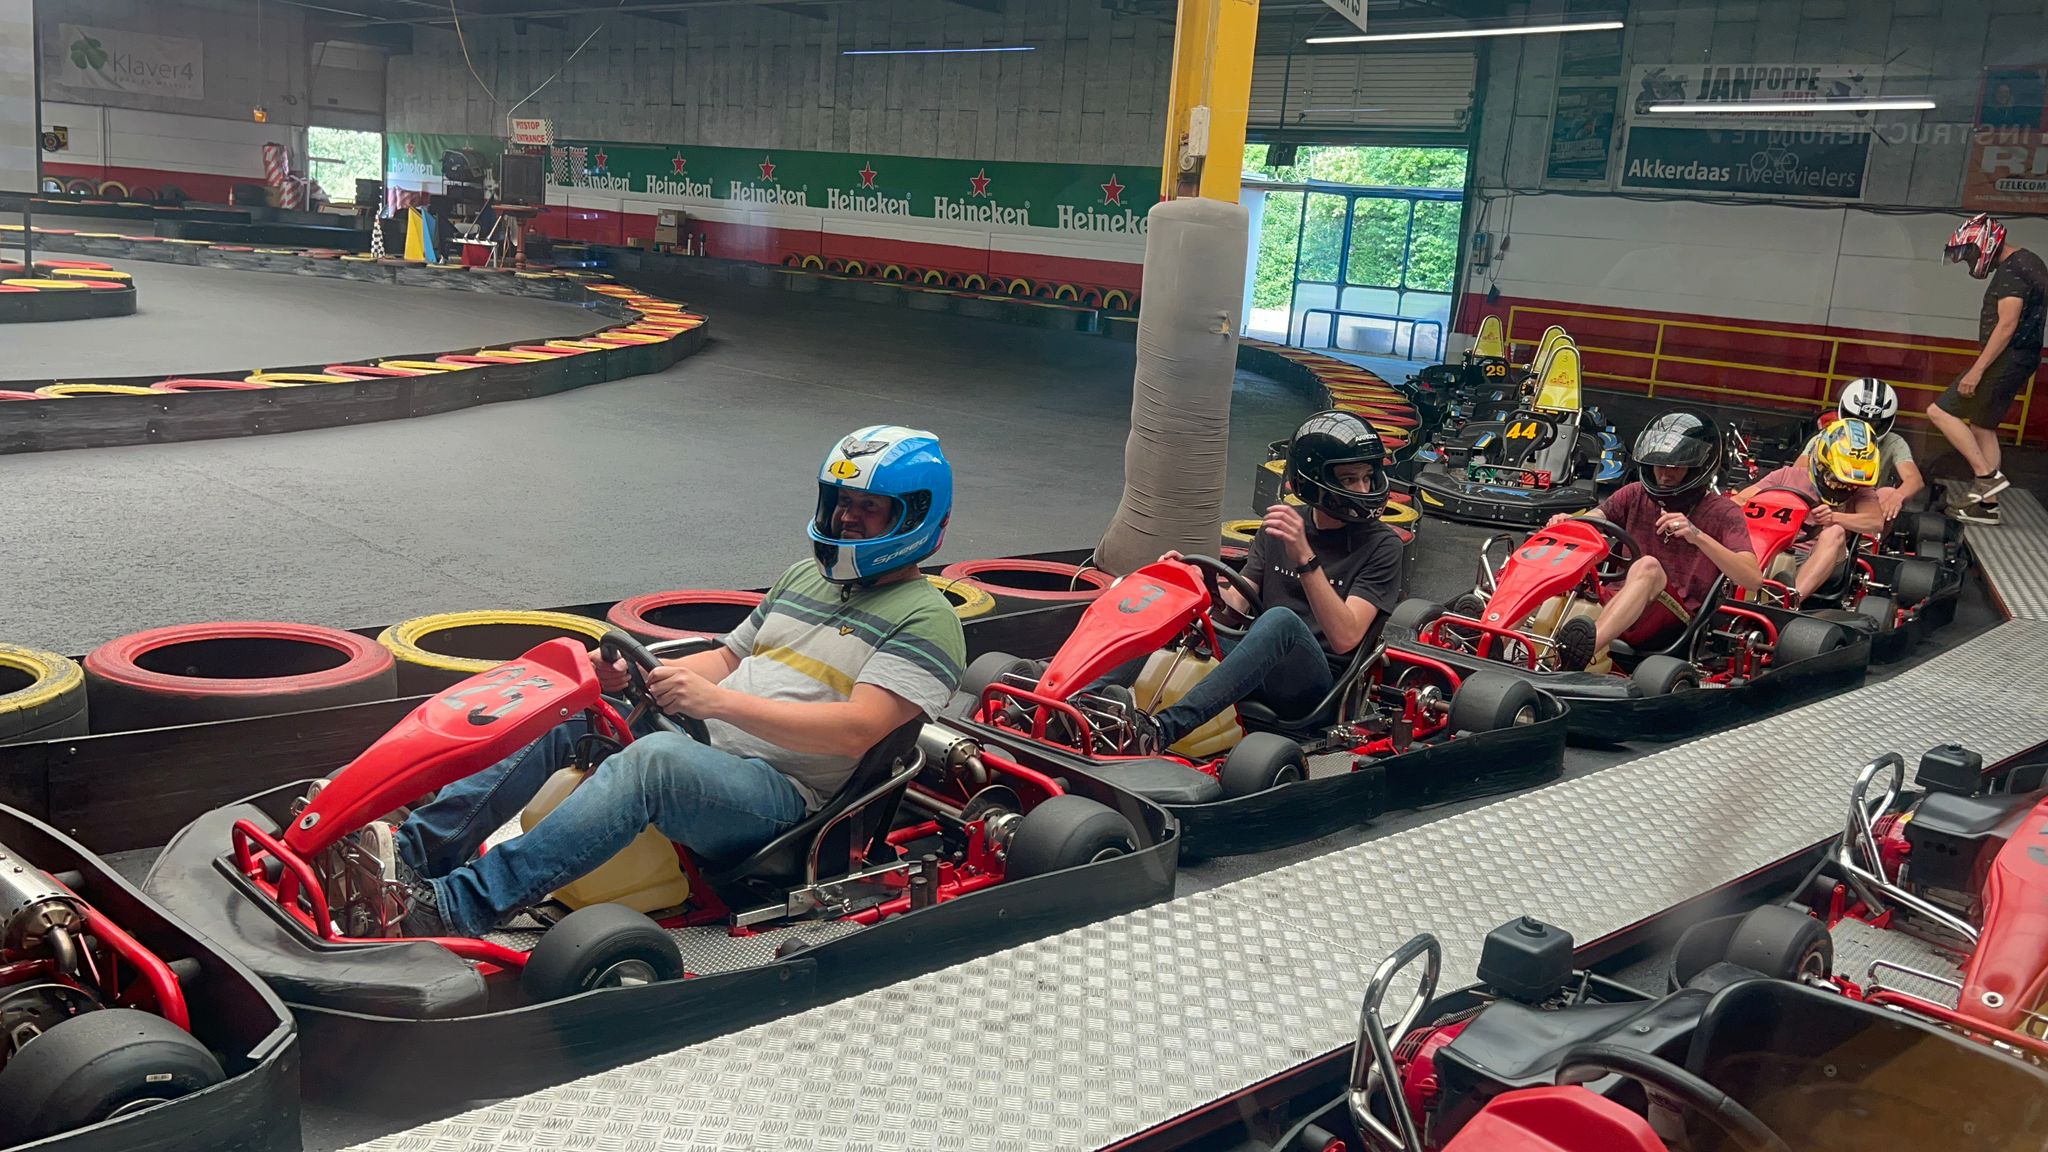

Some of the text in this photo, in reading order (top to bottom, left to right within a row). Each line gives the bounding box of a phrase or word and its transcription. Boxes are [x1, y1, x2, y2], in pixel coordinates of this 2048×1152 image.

[516, 121, 539, 129] PITSTOP
[516, 134, 545, 143] ENTRANCE
[392, 158, 434, 176] Heineken
[1628, 159, 1855, 187] Akkerdaas Tweewielers
[646, 175, 712, 198] Heineken
[730, 181, 807, 207] Heineken
[828, 188, 911, 216] Heineken
[934, 197, 1029, 226] Heineken
[1057, 205, 1149, 234] Heineke
[1486, 365, 1506, 377] 29
[1506, 422, 1537, 440] 44
[1745, 502, 1793, 525] 54
[871, 533, 931, 567] Speed
